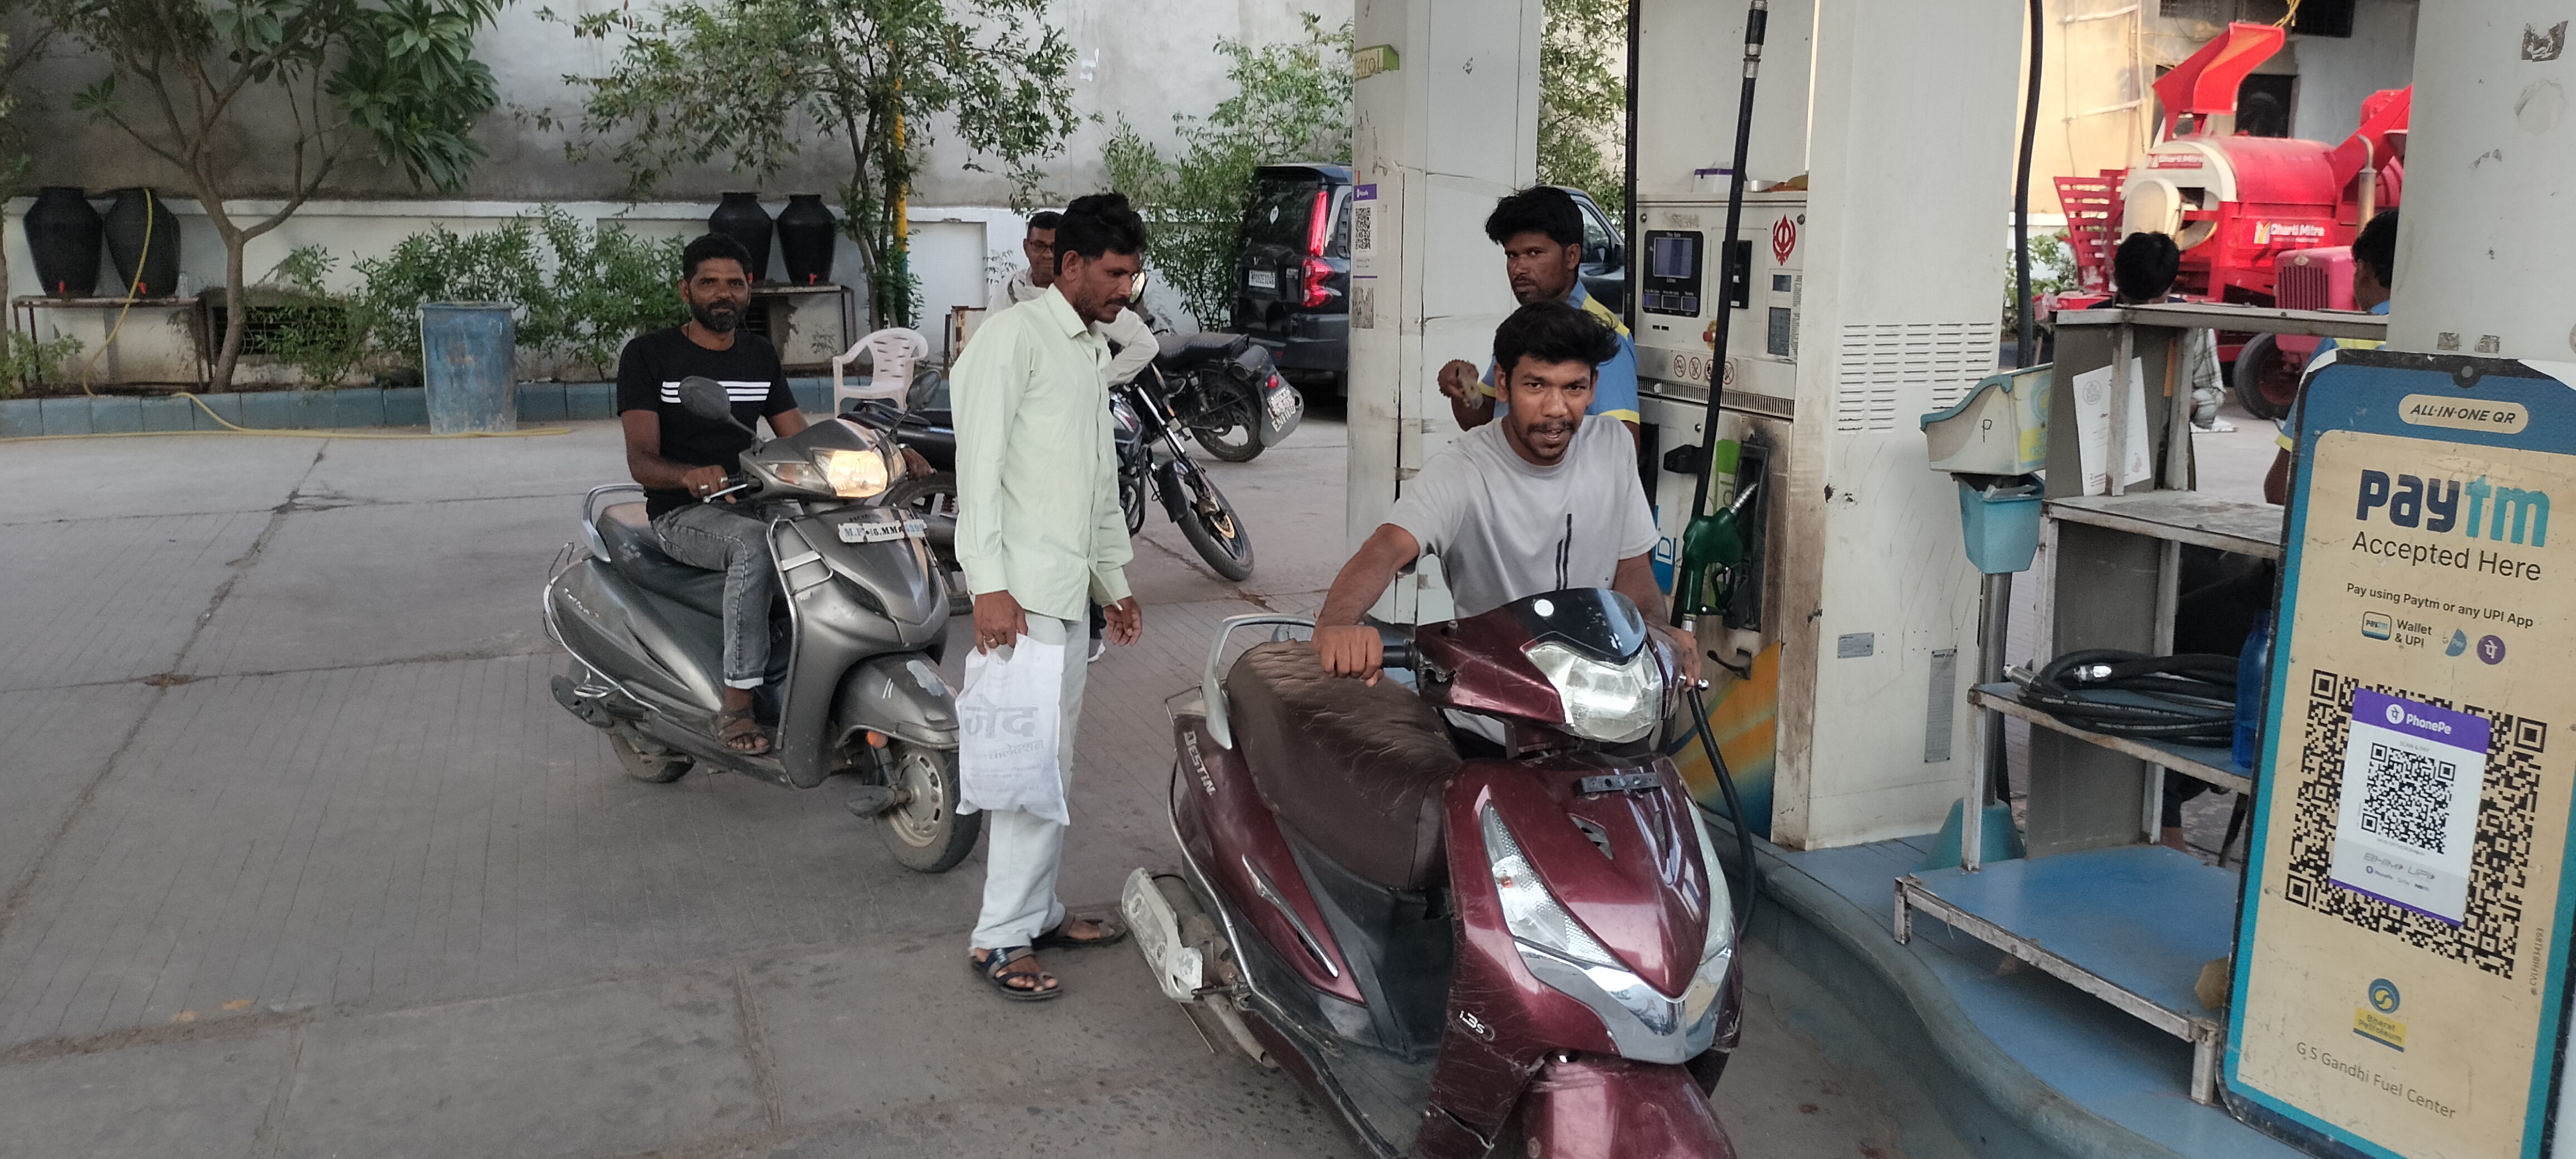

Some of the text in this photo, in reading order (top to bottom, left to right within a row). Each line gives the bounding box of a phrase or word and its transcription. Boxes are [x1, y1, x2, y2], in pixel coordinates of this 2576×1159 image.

[1355, 50, 1380, 76] etrol
[2492, 412, 2516, 424] QR
[2356, 469, 2551, 548] paytm
[2351, 530, 2542, 582] Accepted Here
[2346, 583, 2534, 628] Pay using Paytm or any UPI App
[2394, 633, 2424, 647] & UPI
[2397, 619, 2432, 635] Wallet
[2406, 713, 2452, 735] PhonePe
[1183, 730, 1216, 796] DESTIN
[2296, 1041, 2456, 1119] G S Gandhi Fuel Center
